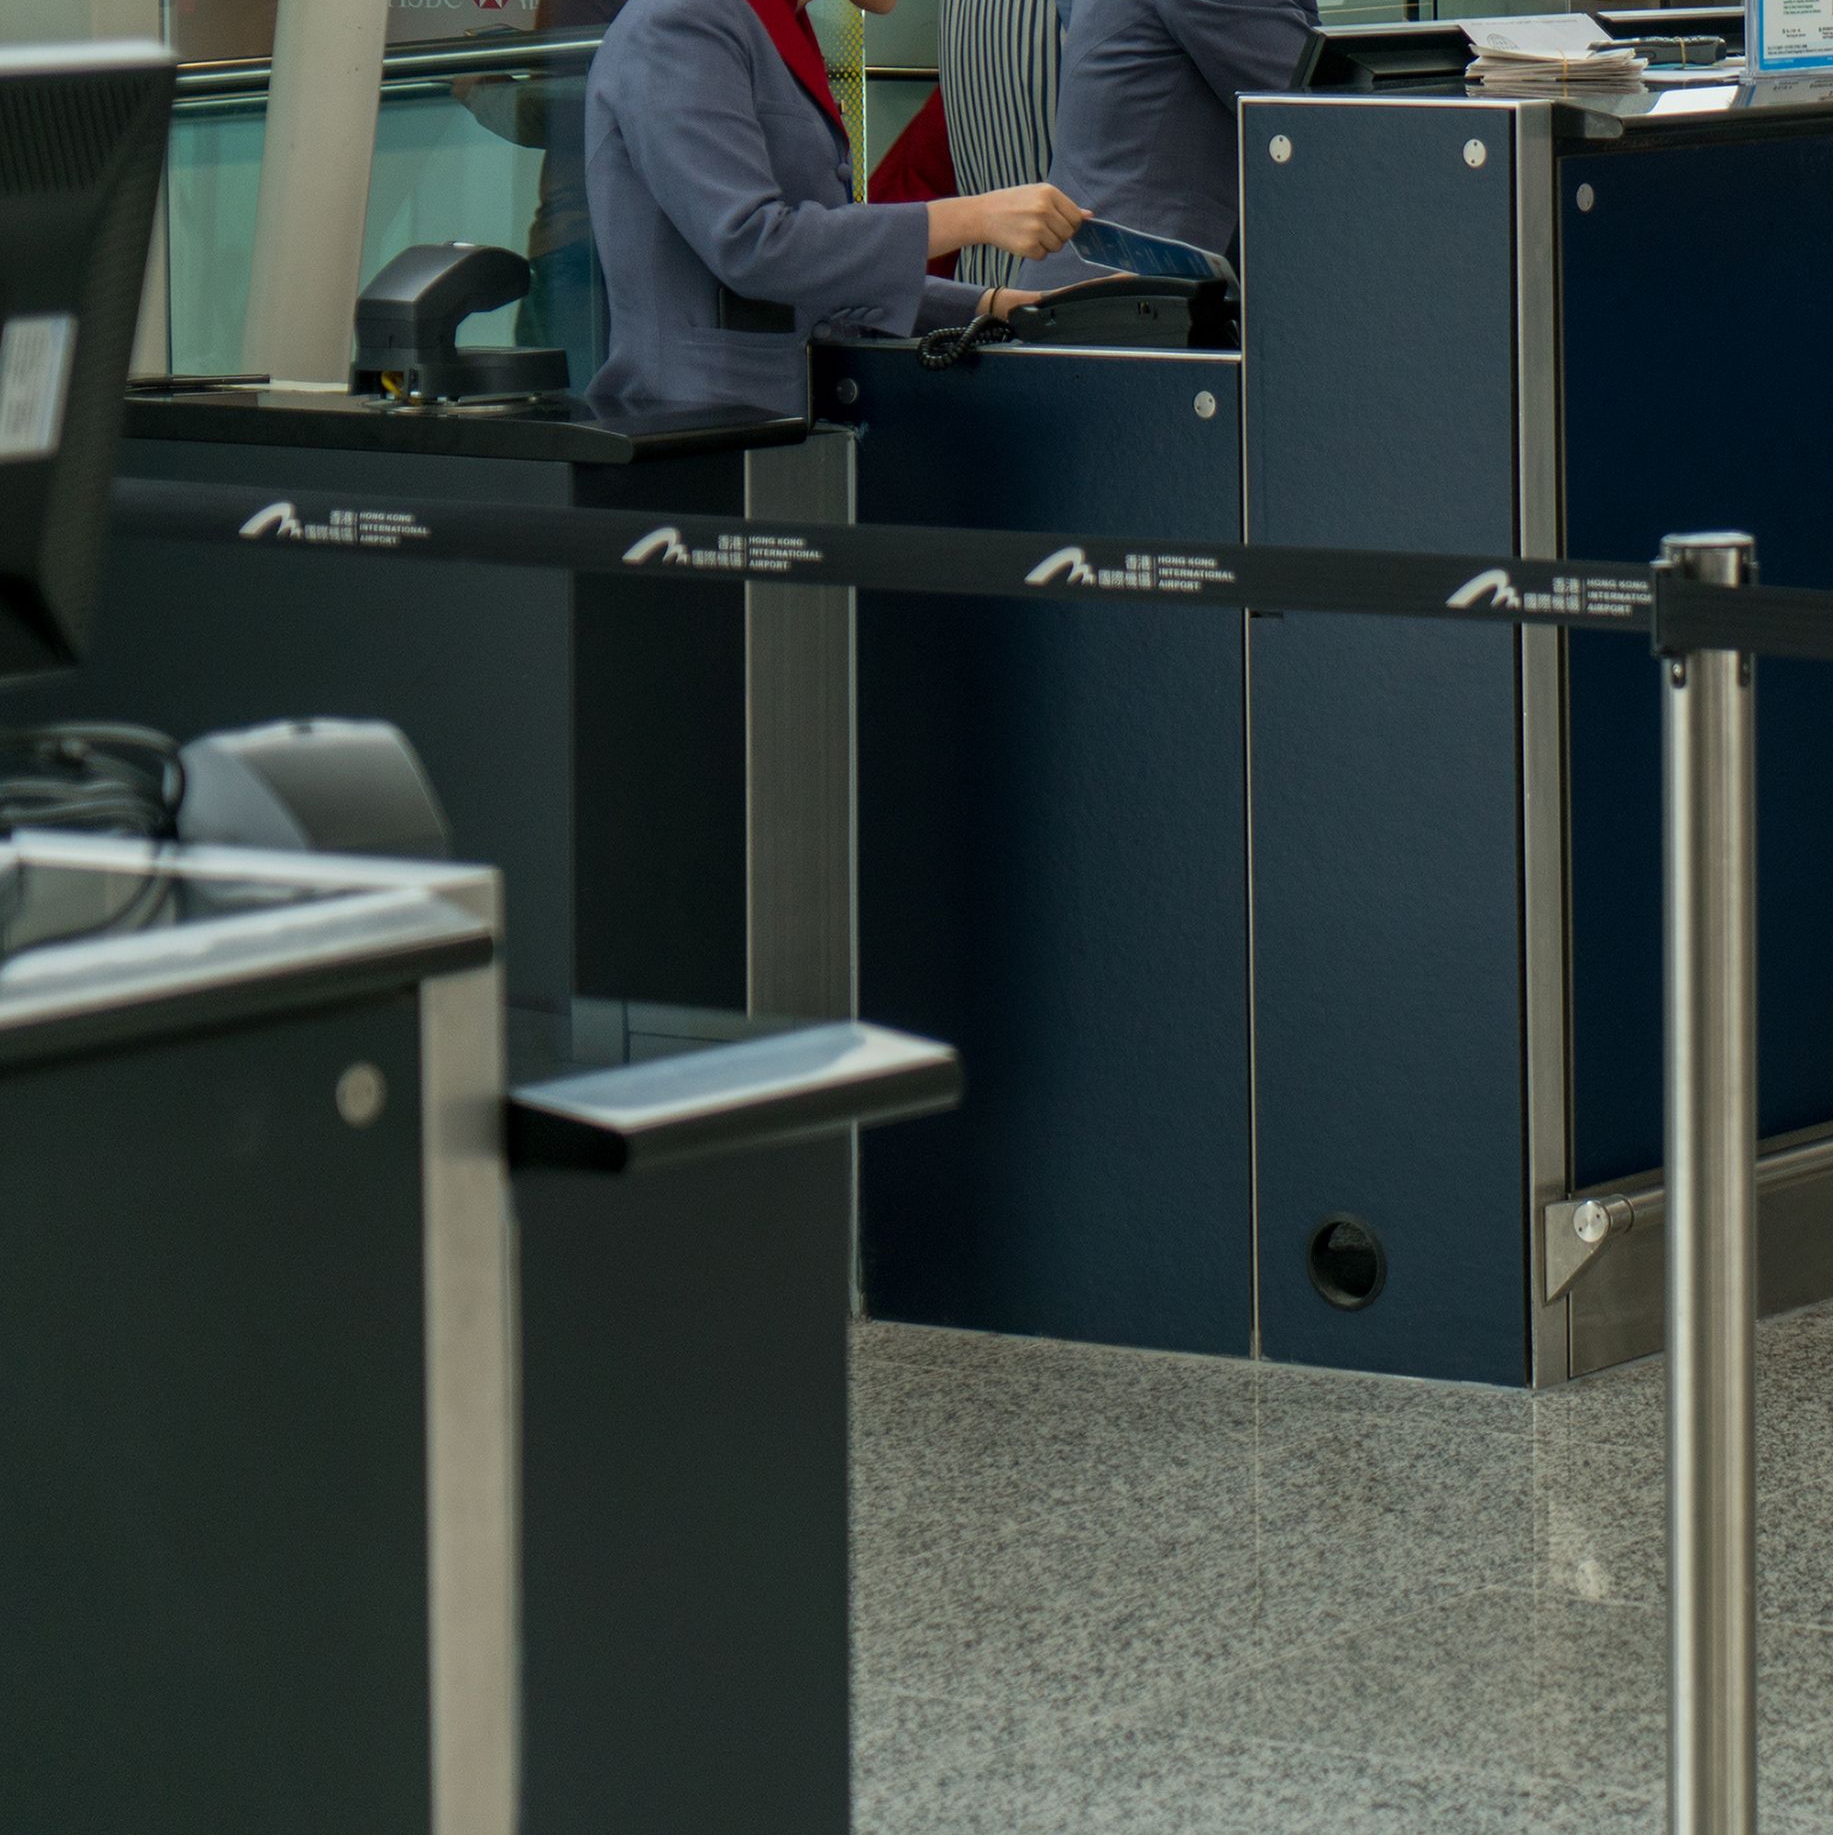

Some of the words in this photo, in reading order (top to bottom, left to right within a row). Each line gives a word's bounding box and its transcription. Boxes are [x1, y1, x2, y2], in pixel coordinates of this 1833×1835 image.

[359, 512, 384, 522] HONG
[386, 513, 415, 523] KONG
[359, 523, 431, 536] INTERNATIONAL
[360, 534, 400, 545] AIRPORT
[749, 536, 776, 546] HONG
[778, 537, 805, 548] KONG
[749, 547, 823, 561] INTERNATIONAL
[749, 559, 790, 571] AIRPORT
[1158, 556, 1186, 566] HONG
[1188, 557, 1217, 567] KONG
[1159, 568, 1235, 582] INTERNATIONAL
[1159, 579, 1201, 590] AIRPORT
